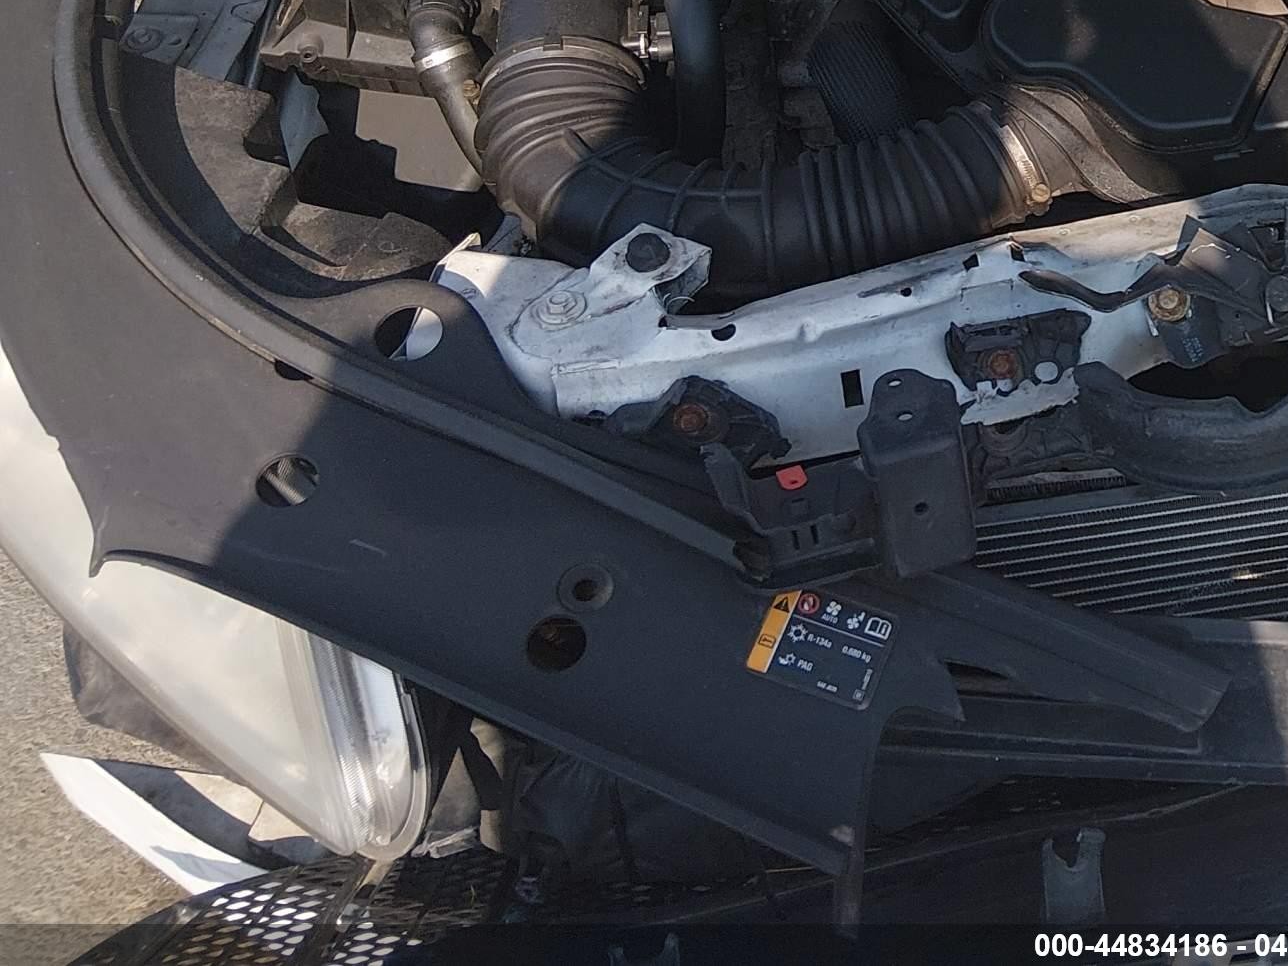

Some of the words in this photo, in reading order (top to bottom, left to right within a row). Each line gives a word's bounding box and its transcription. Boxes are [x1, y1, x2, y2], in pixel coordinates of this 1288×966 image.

[822, 613, 837, 623] AUTO
[807, 634, 832, 648] R-134a
[862, 652, 871, 663] kg
[797, 660, 813, 671] PAG
